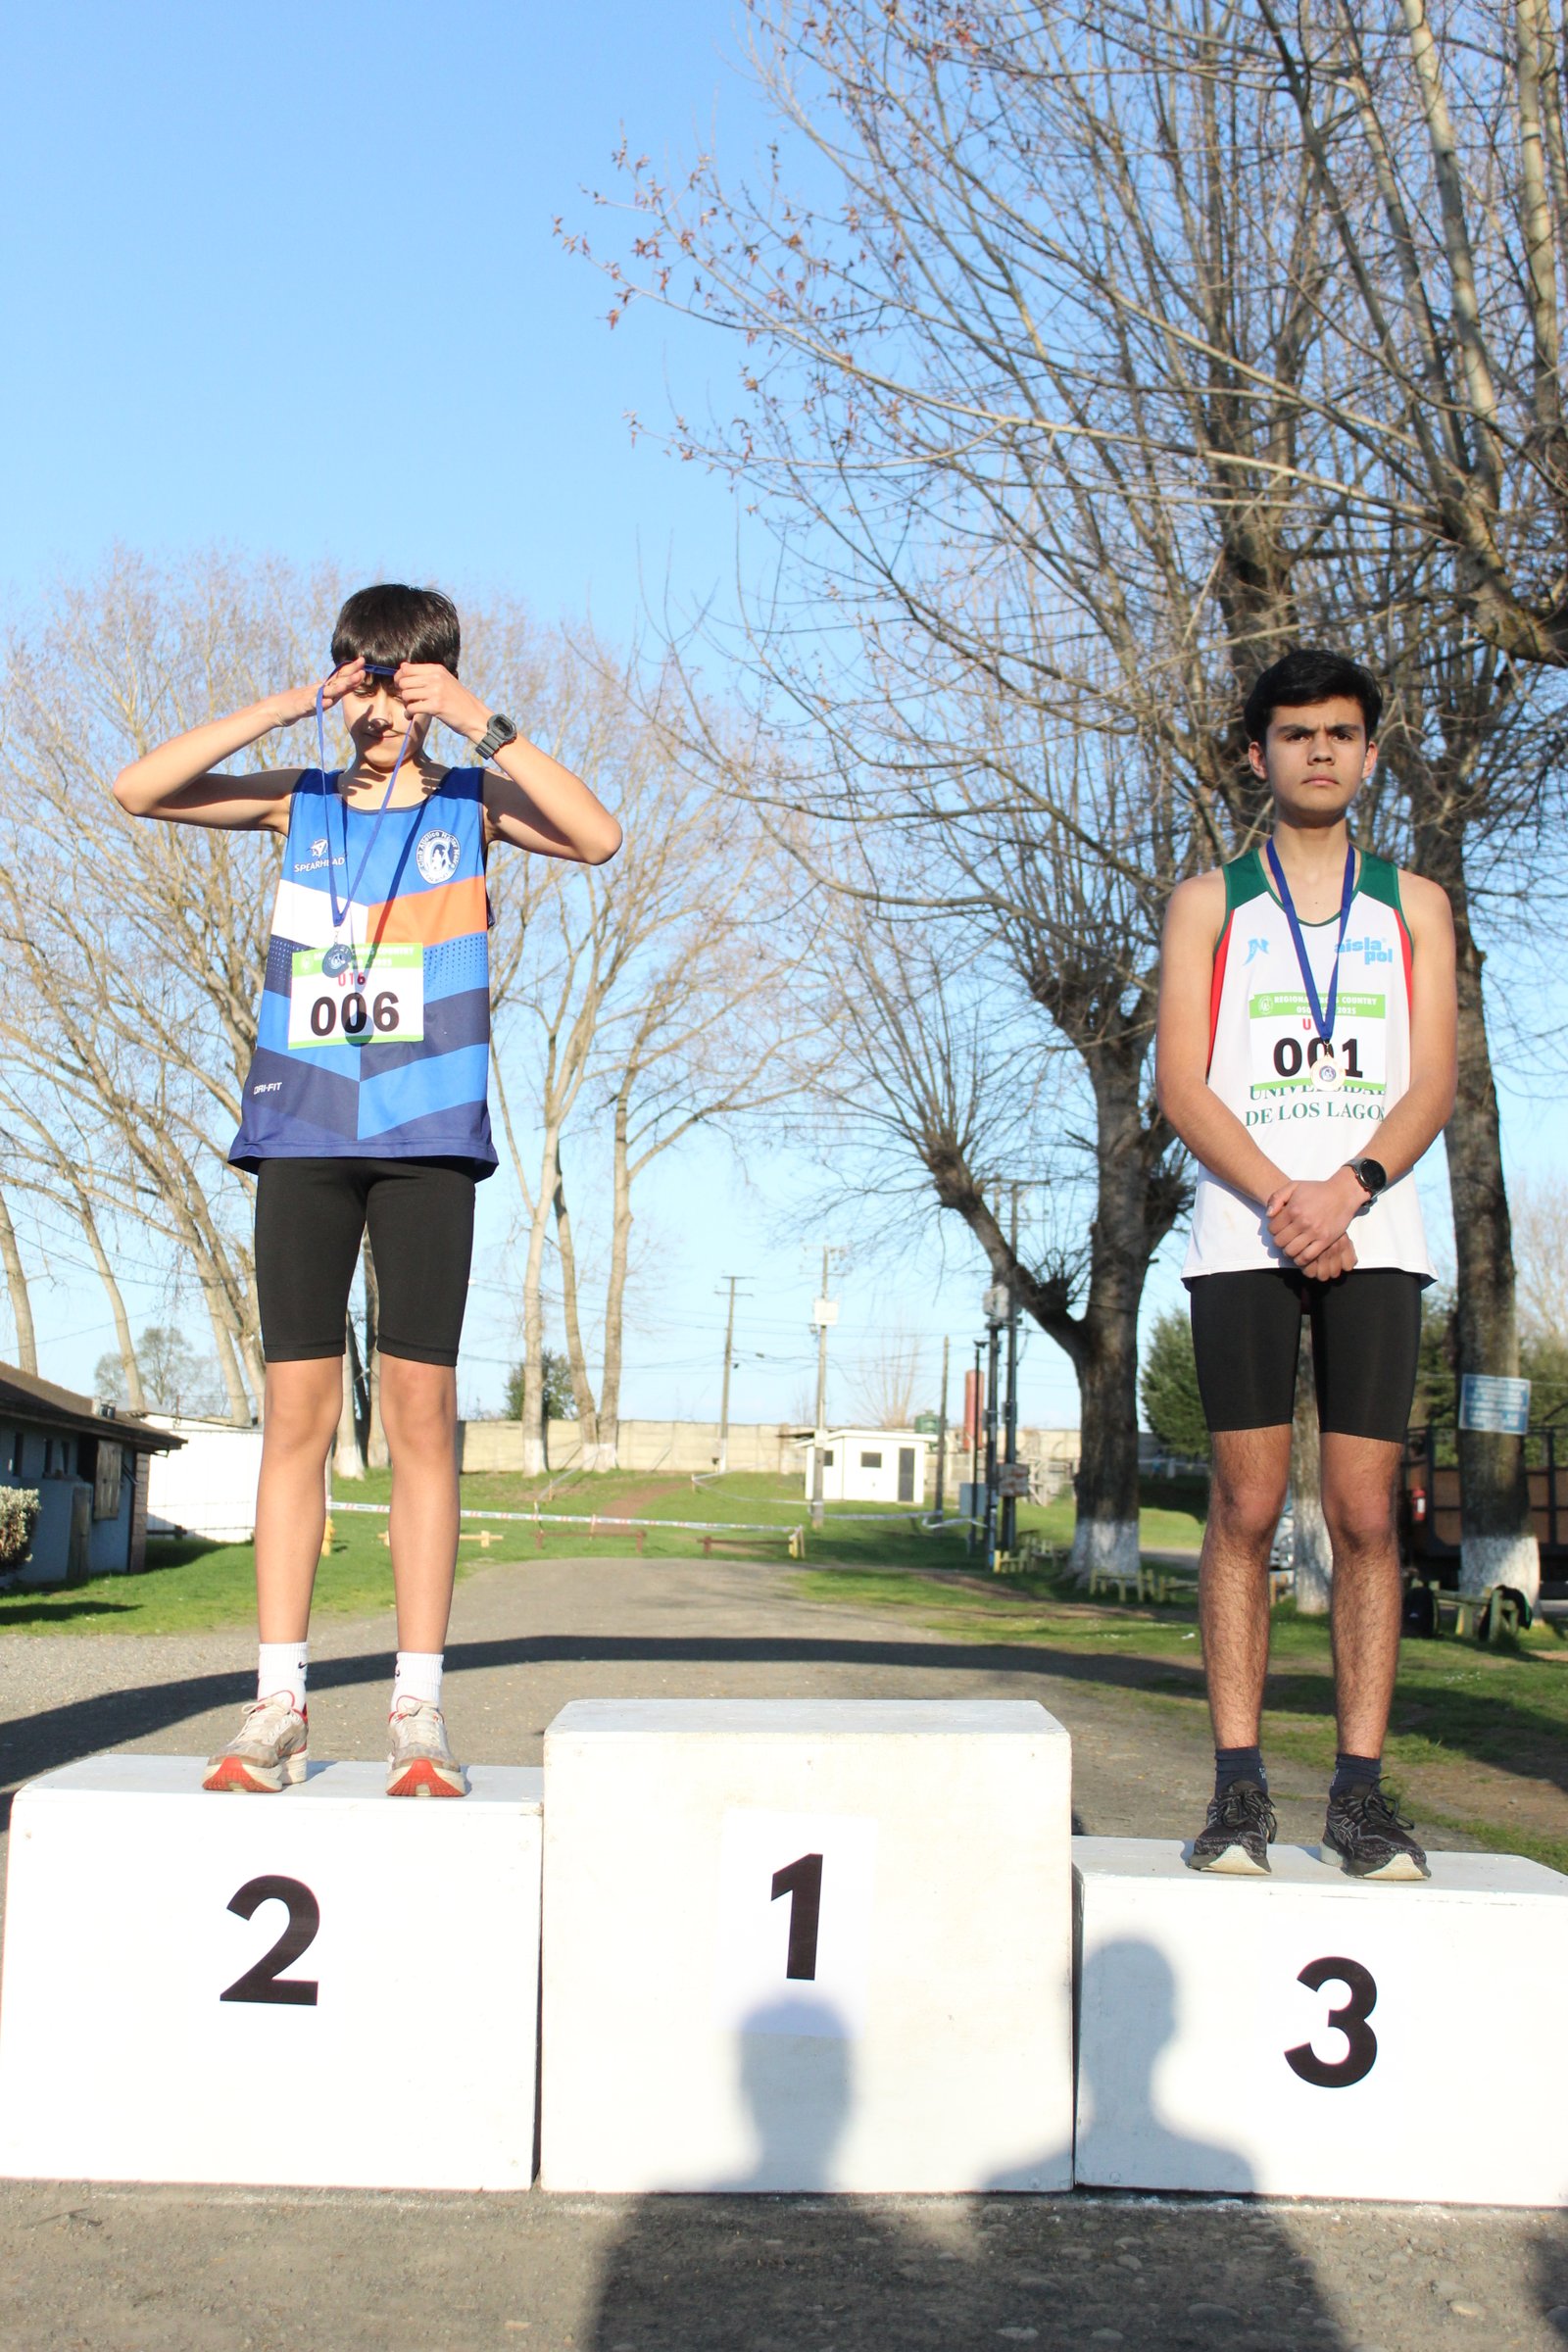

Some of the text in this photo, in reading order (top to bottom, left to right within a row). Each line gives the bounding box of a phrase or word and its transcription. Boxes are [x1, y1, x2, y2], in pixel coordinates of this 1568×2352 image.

[1364, 948, 1394, 965] pol
[311, 991, 399, 1037] 006
[1274, 996, 1308, 1004] REGIONA
[1342, 996, 1377, 1005] COUNTRY
[1273, 1037, 1363, 1079] 001
[253, 1081, 283, 1095] DRI-FIT
[1246, 1107, 1273, 1126] DE
[1278, 1102, 1320, 1121] LOS
[770, 1853, 824, 1981] 1
[220, 1875, 320, 2006] 2
[1284, 1956, 1378, 2088] 3
